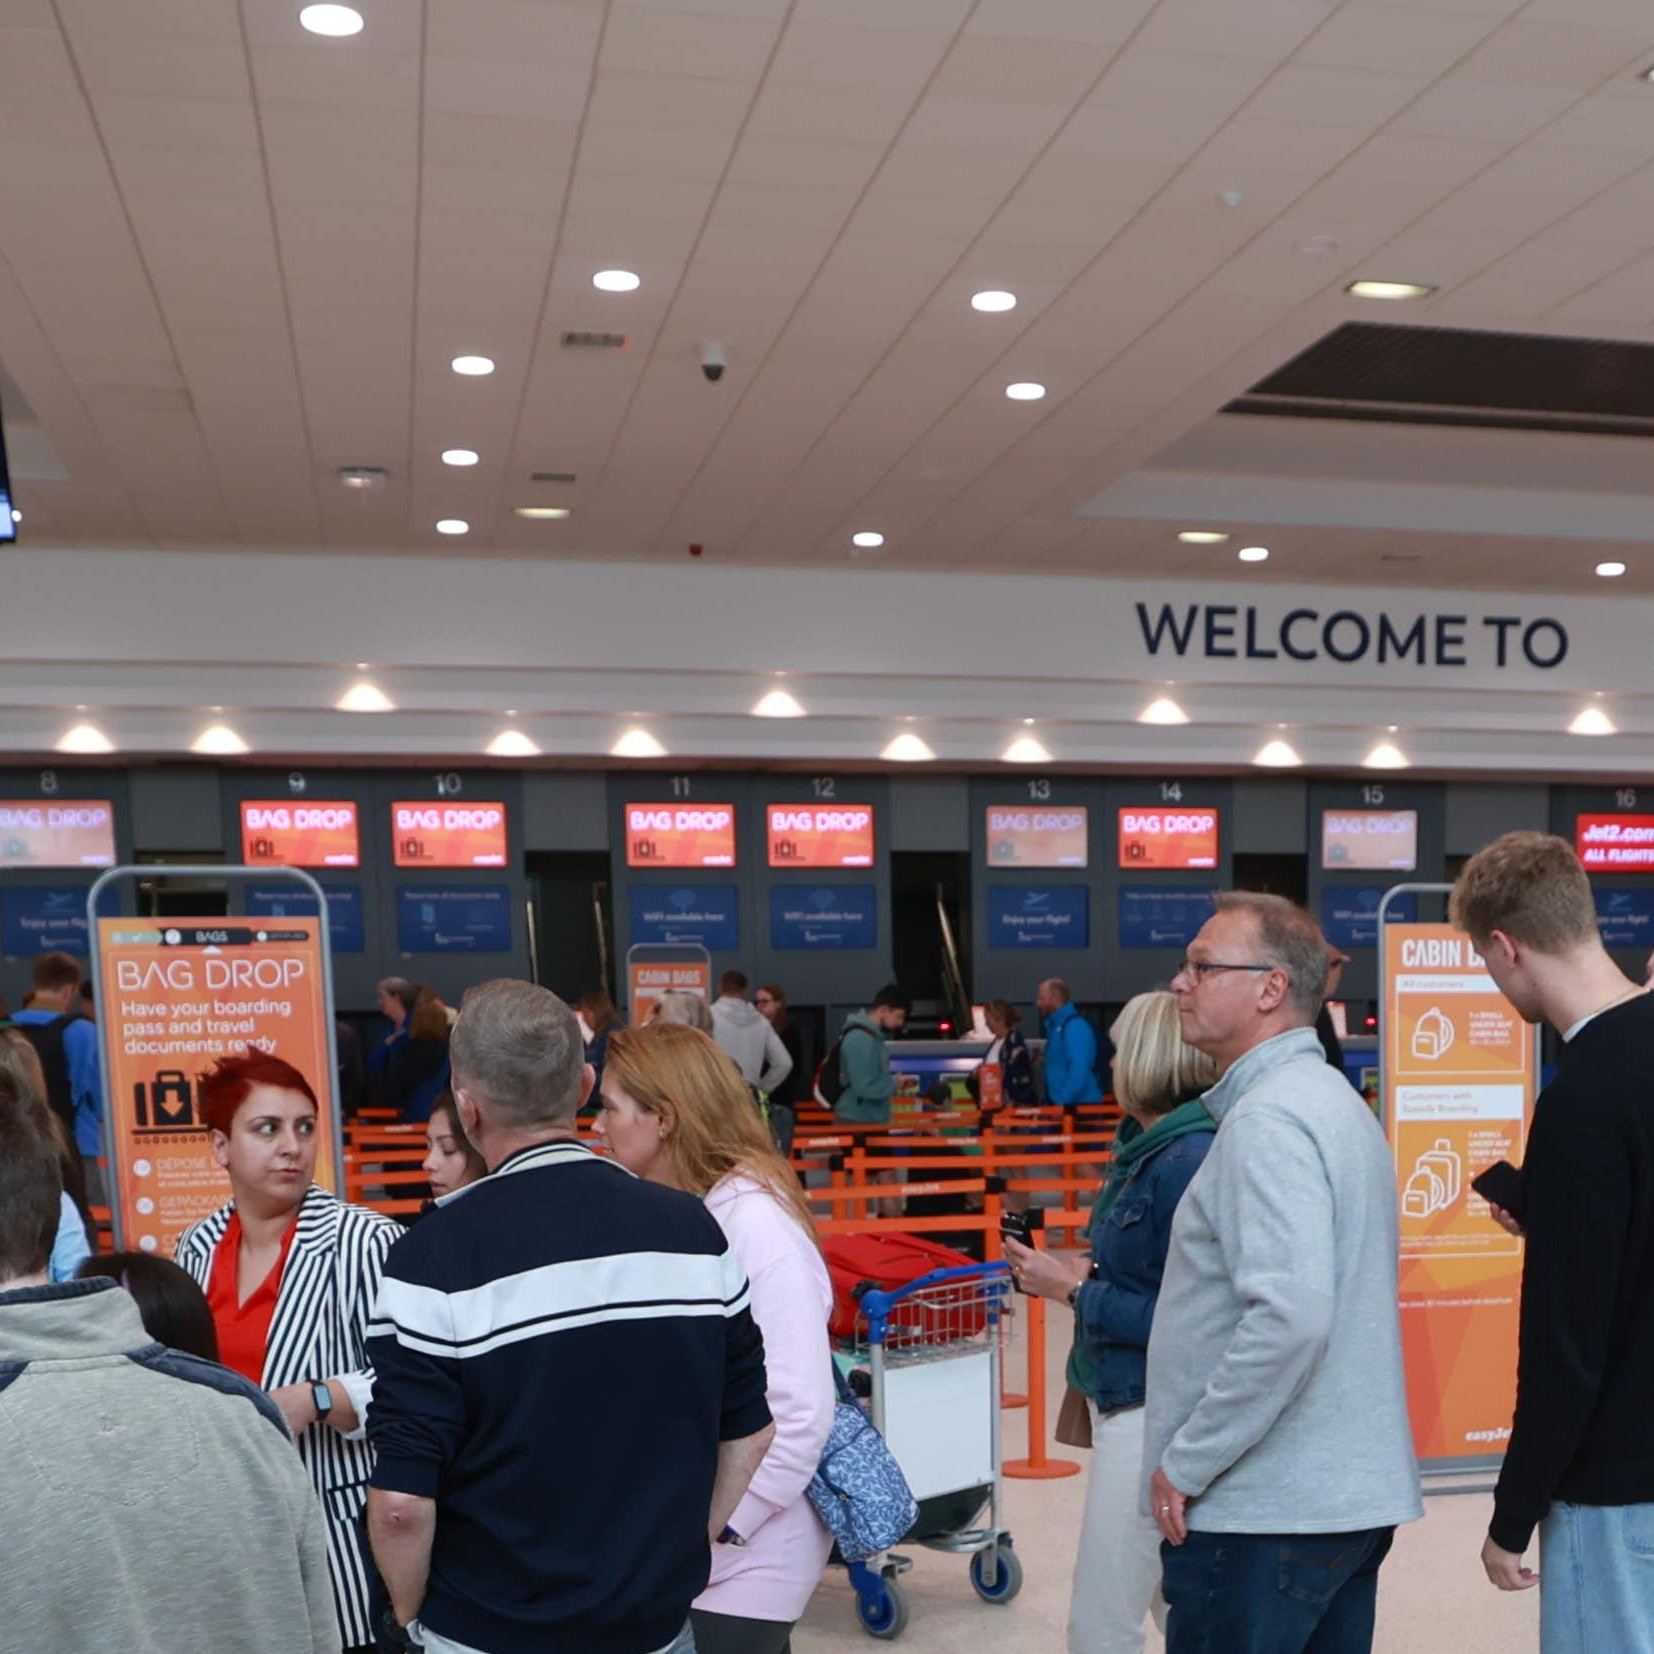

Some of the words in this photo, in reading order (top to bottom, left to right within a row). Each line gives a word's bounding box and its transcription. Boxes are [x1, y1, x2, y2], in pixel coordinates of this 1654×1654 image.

[1136, 602, 1467, 666] WELCOME
[1483, 617, 1568, 668] TO
[40, 771, 58, 794] 8
[435, 772, 462, 795] 10
[671, 777, 690, 796] 11
[811, 777, 835, 797] 12
[1027, 780, 1050, 799] 13
[1159, 782, 1182, 801] 14
[1361, 786, 1384, 804] 15
[1615, 789, 1636, 808] 16
[0, 808, 41, 828] BAG
[48, 808, 108, 828] DROP
[246, 808, 290, 829] BAG
[294, 808, 352, 829] DROP
[397, 809, 440, 829] BAG
[444, 809, 500, 829] DROP
[630, 811, 672, 830] BAG
[675, 811, 730, 830] DROP
[772, 812, 812, 831] BAG
[816, 812, 869, 831] DROP
[990, 814, 1029, 832] BAG
[1033, 814, 1084, 832] DROP
[1123, 815, 1160, 833] BAG
[1164, 815, 1214, 833] DROP
[1584, 848, 1606, 863] ALL
[196, 931, 228, 942] BAGS
[1402, 939, 1461, 967] CABIN
[117, 960, 194, 990] BAG
[205, 959, 304, 989] DROP
[122, 1001, 166, 1016] Have
[171, 1004, 209, 1018] your
[214, 1000, 291, 1017] boarding
[123, 1022, 164, 1036] pass
[169, 1020, 201, 1034] and
[206, 1019, 255, 1034] travel
[125, 1038, 223, 1055] documents
